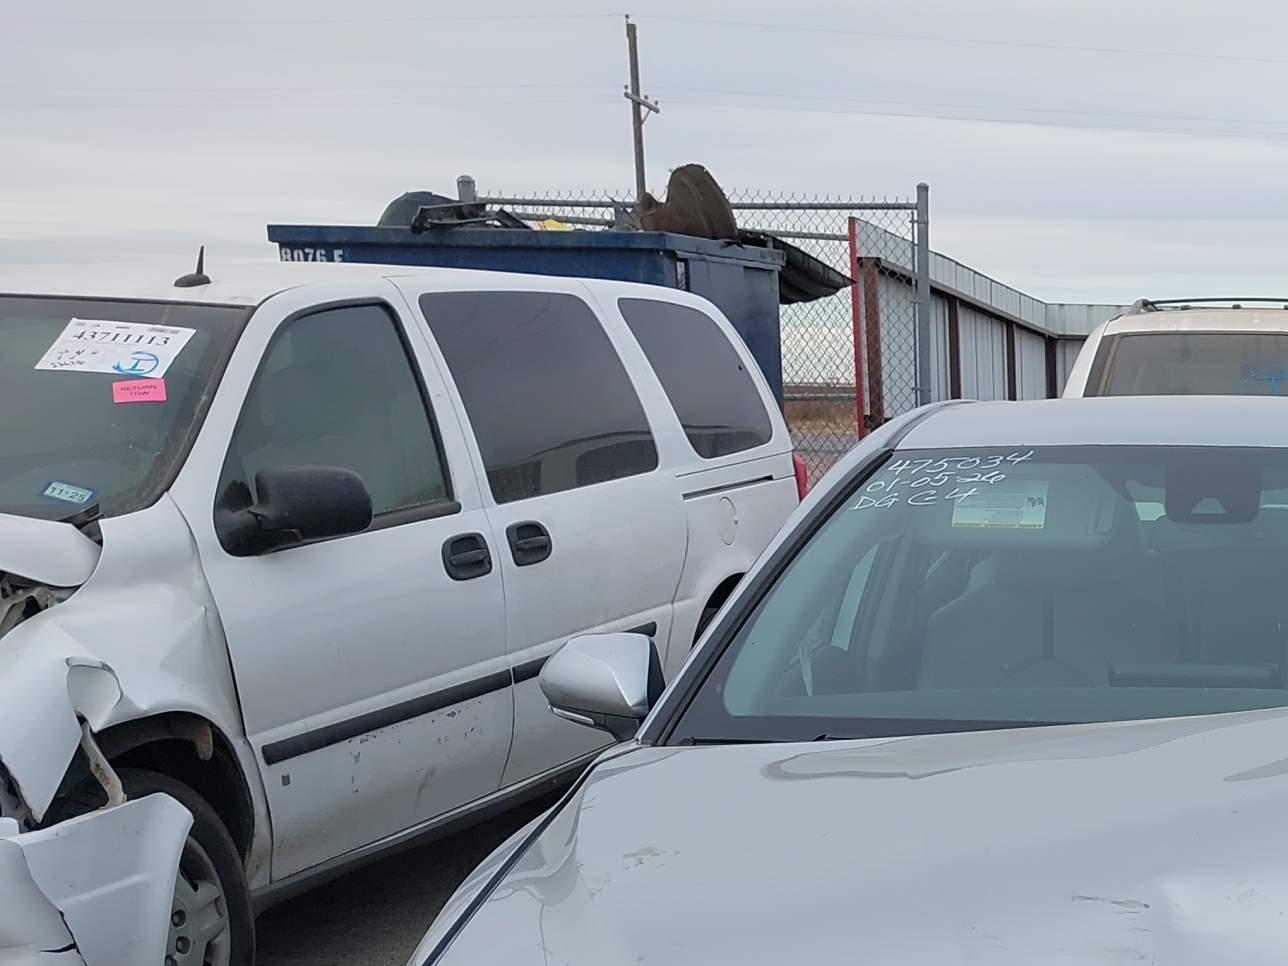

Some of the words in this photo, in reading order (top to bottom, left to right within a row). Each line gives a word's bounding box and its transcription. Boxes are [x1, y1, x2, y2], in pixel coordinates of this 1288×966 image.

[72, 331, 171, 346] 43711113
[888, 450, 1034, 474] 475034
[866, 471, 1006, 493] 01-05-26
